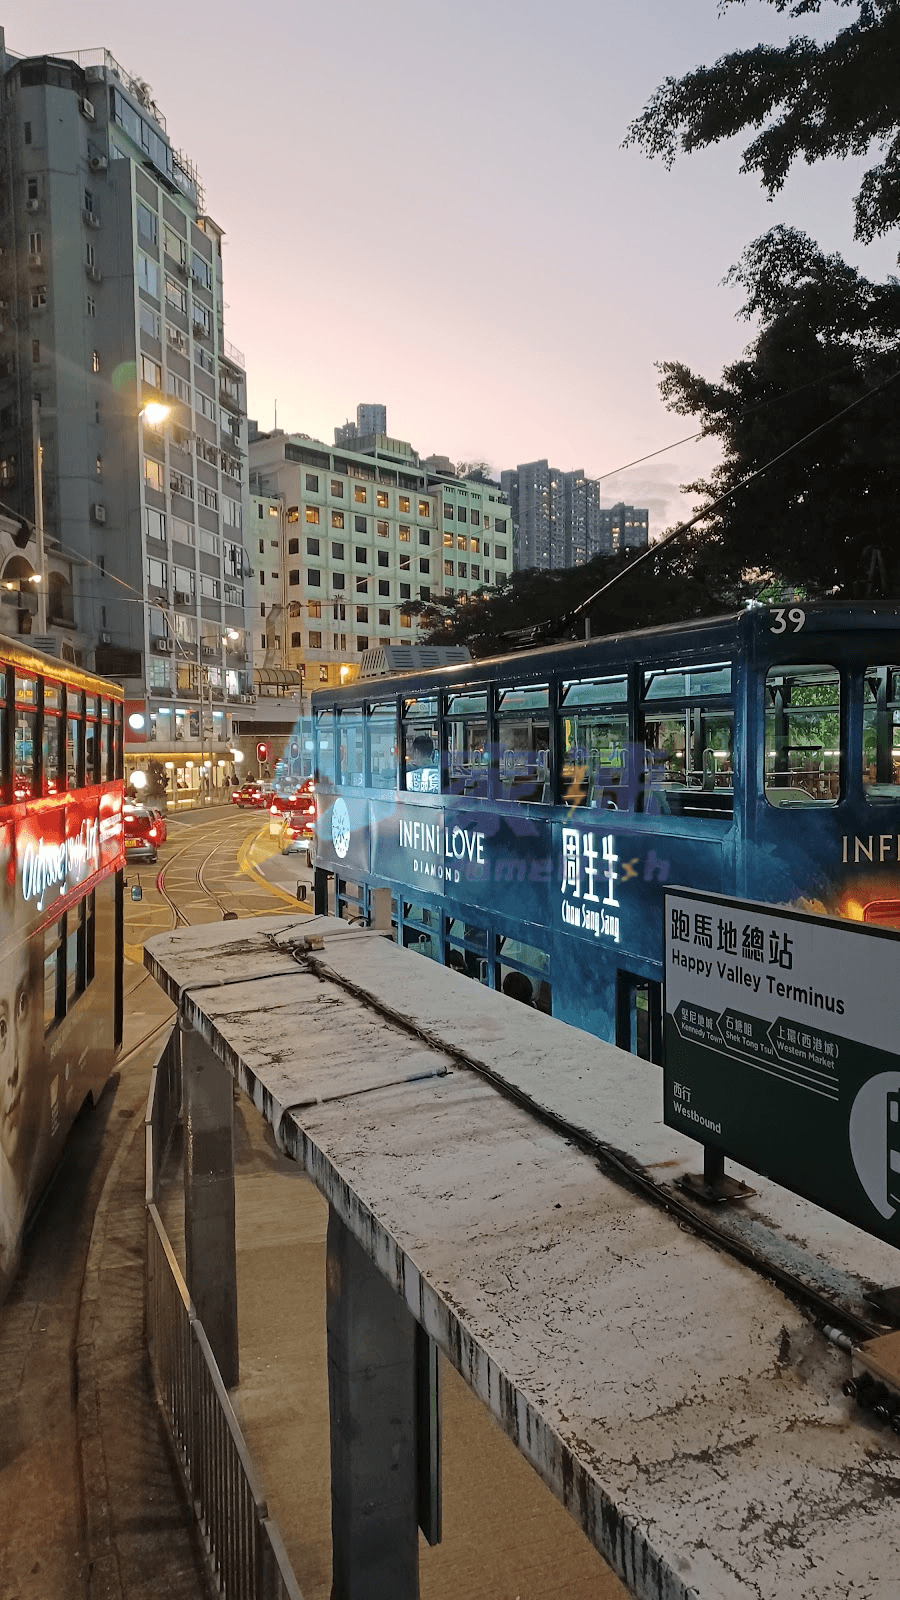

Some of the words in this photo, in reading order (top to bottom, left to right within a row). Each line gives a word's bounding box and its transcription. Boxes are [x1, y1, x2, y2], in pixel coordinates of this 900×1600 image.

[769, 607, 806, 634] 39
[399, 819, 440, 855] INFINI
[445, 825, 485, 864] LOVE
[413, 859, 460, 883] DIAMOND
[561, 828, 620, 908] 周生生
[561, 899, 581, 927] Chow
[581, 903, 600, 937] Sang
[600, 908, 620, 943] Sang
[671, 908, 794, 970] 跑馬地總站
[671, 948, 713, 978] Happy
[716, 961, 761, 993] Valley
[766, 974, 845, 1015] Terminus
[681, 1007, 714, 1031] 堅尼地城
[681, 1021, 706, 1039] Kennedy
[706, 1031, 723, 1045] Town
[725, 1030, 741, 1044] Shek
[742, 1036, 759, 1051] Tong
[760, 1042, 774, 1055] Tsui
[776, 1040, 807, 1059] Western
[808, 1051, 835, 1070] Market
[673, 1081, 692, 1103] 西行
[673, 1101, 722, 1135] Westbound
